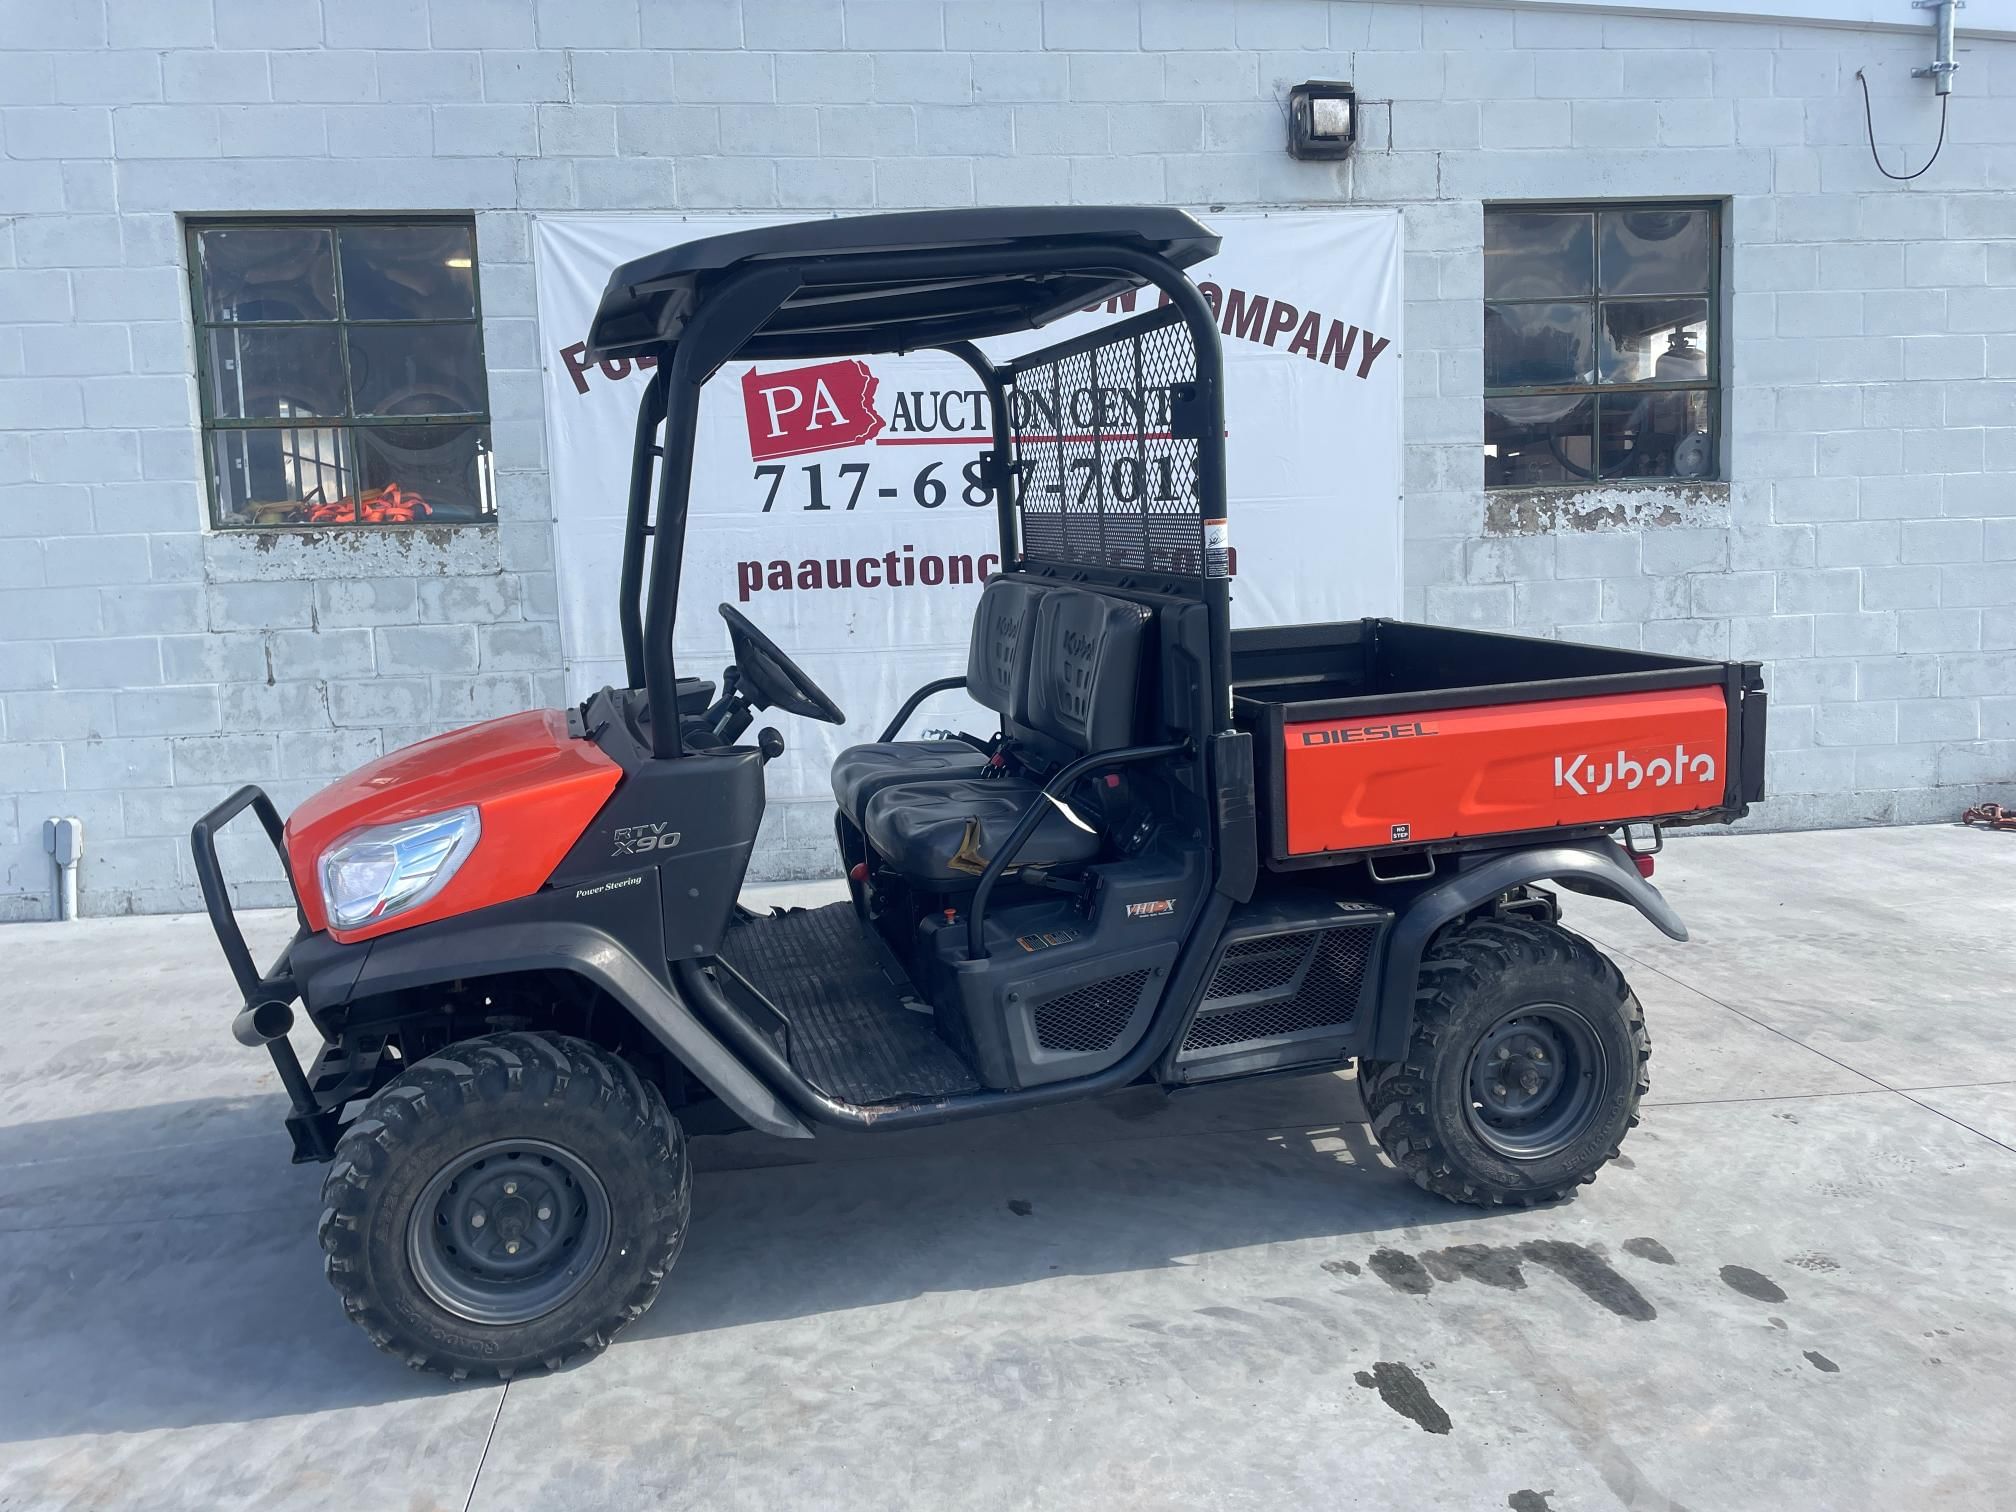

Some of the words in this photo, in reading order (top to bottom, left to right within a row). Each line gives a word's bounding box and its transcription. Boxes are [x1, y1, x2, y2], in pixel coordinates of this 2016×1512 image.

[758, 377, 850, 439] PA
[889, 387, 1058, 433] AUCTON
[1071, 385, 1226, 430] CENT
[1302, 722, 1439, 746] DIESEL
[1554, 743, 1715, 796] Kubota
[613, 821, 668, 841] RTV
[611, 832, 681, 857] X90
[575, 885, 605, 899] Power
[604, 876, 642, 892] Steering
